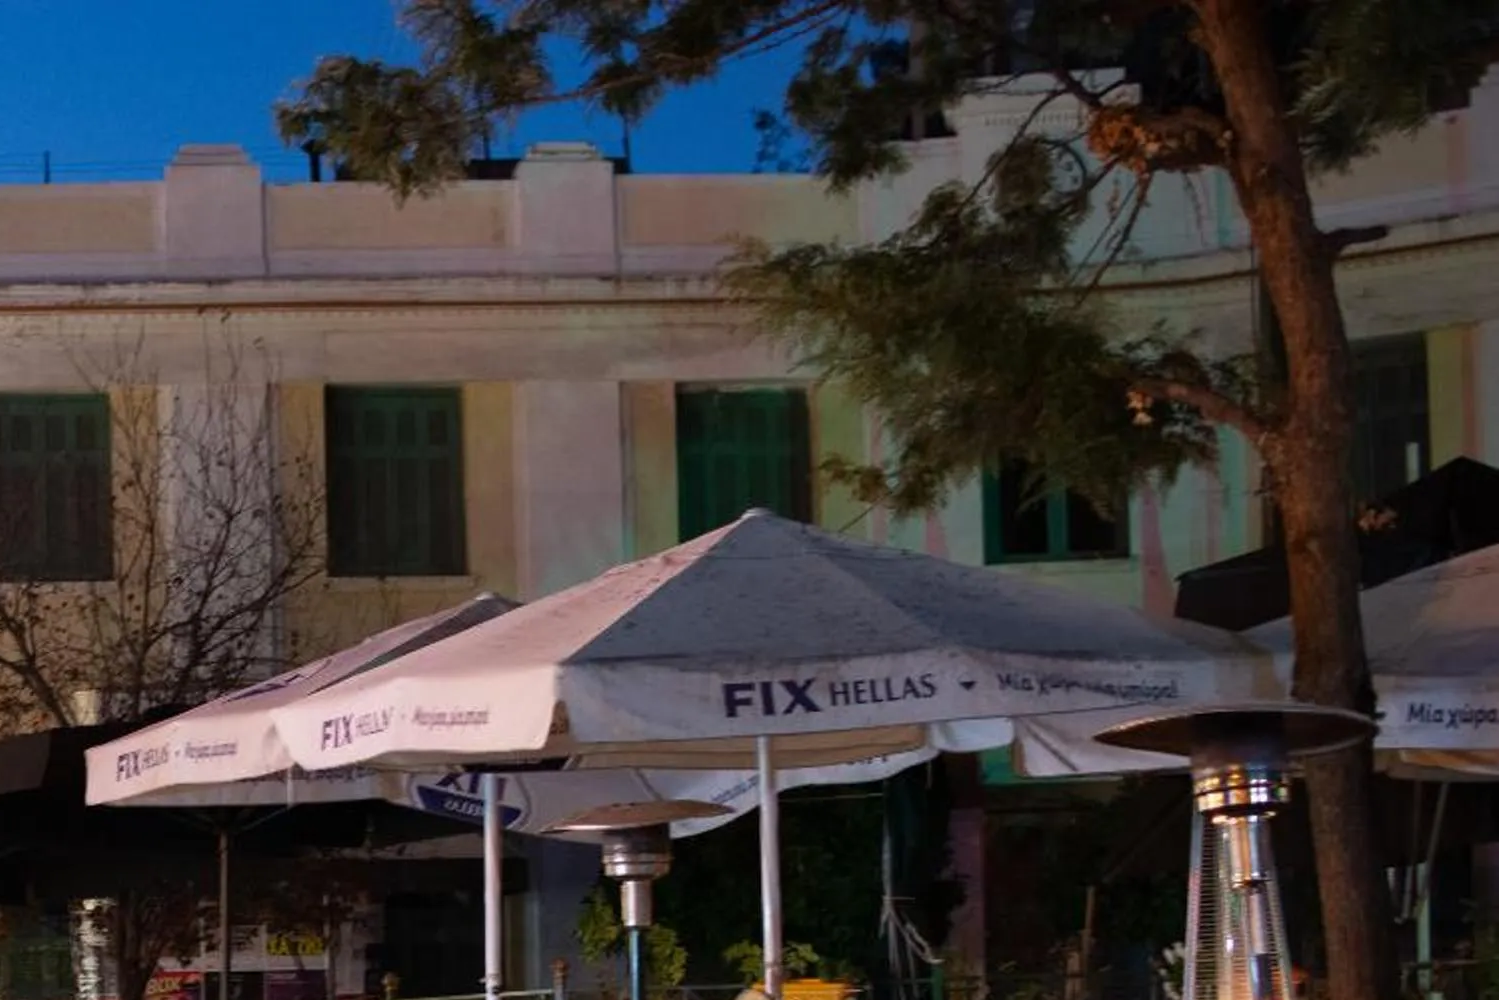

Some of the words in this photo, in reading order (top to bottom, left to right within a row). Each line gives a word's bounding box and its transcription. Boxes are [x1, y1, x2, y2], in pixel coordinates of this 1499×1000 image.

[722, 677, 823, 718] FIX
[829, 673, 938, 706] HELLAS
[321, 714, 354, 751] FIX
[116, 748, 142, 782] FIX
